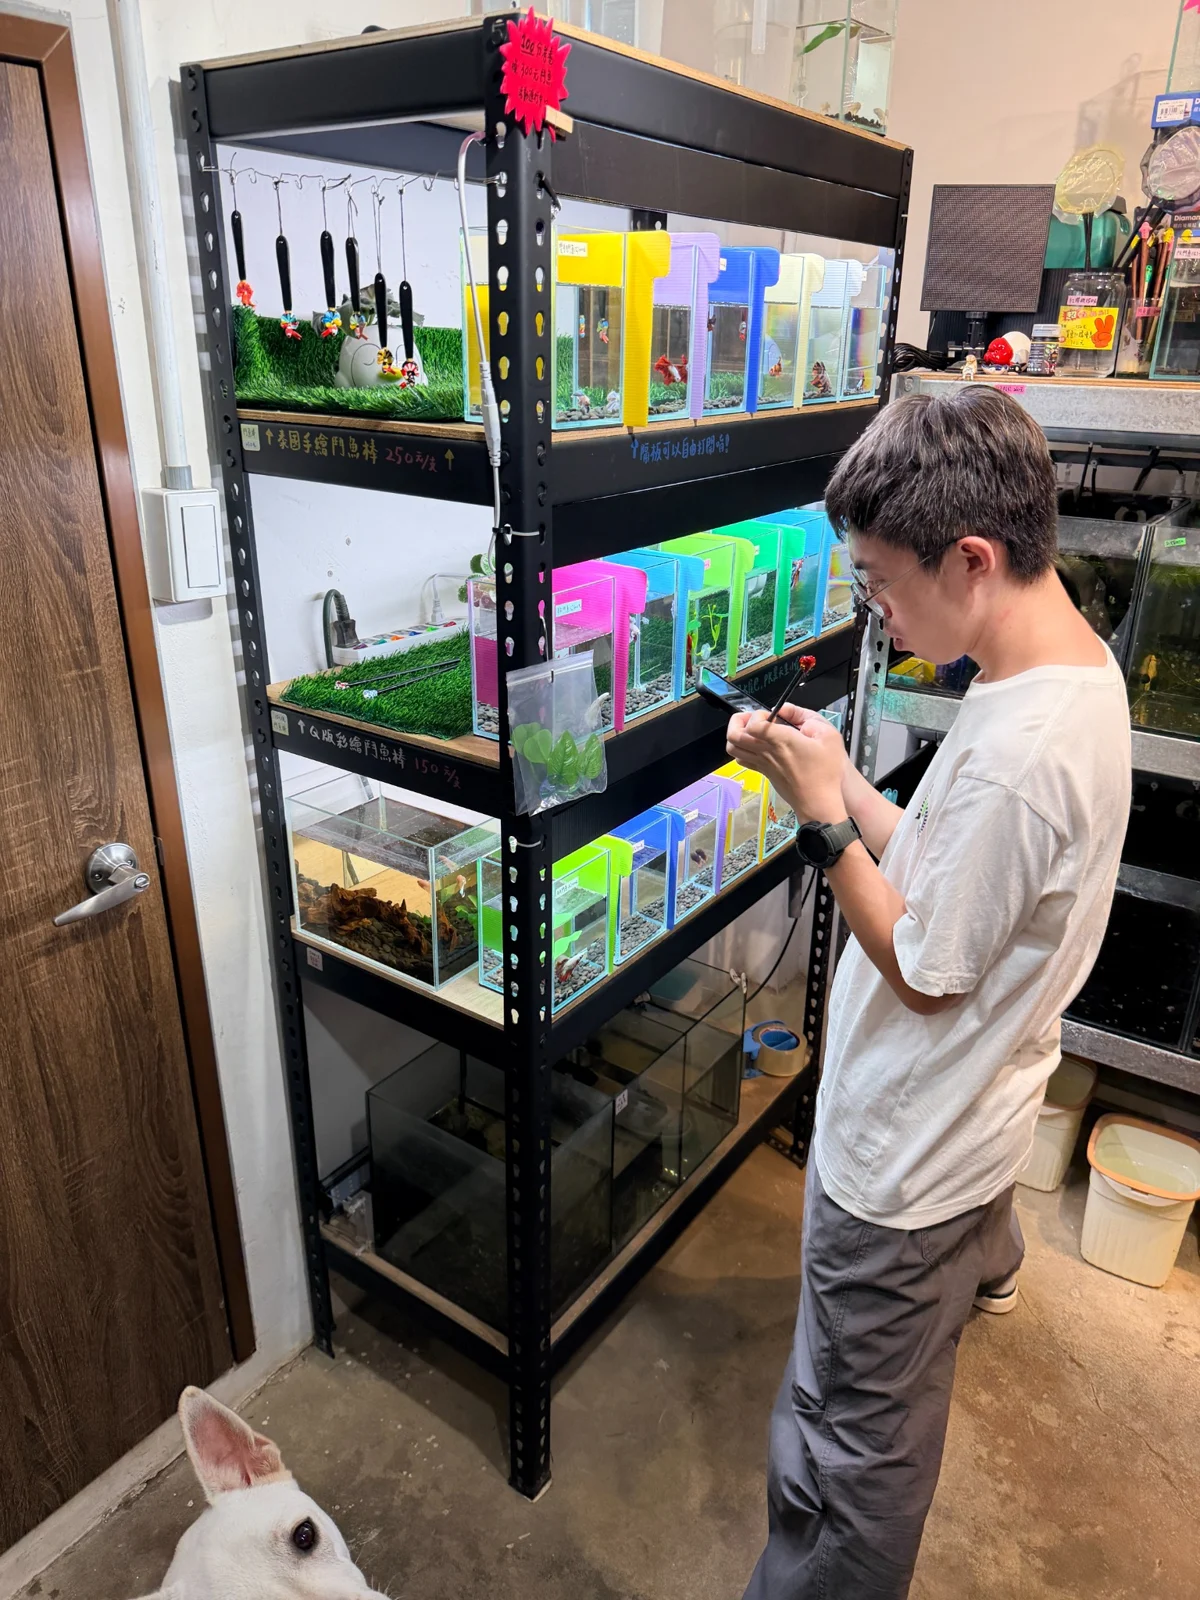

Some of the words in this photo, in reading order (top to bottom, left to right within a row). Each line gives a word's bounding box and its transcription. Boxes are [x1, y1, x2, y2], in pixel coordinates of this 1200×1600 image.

[277, 428, 379, 465] 泰國手繪鬥魚棒
